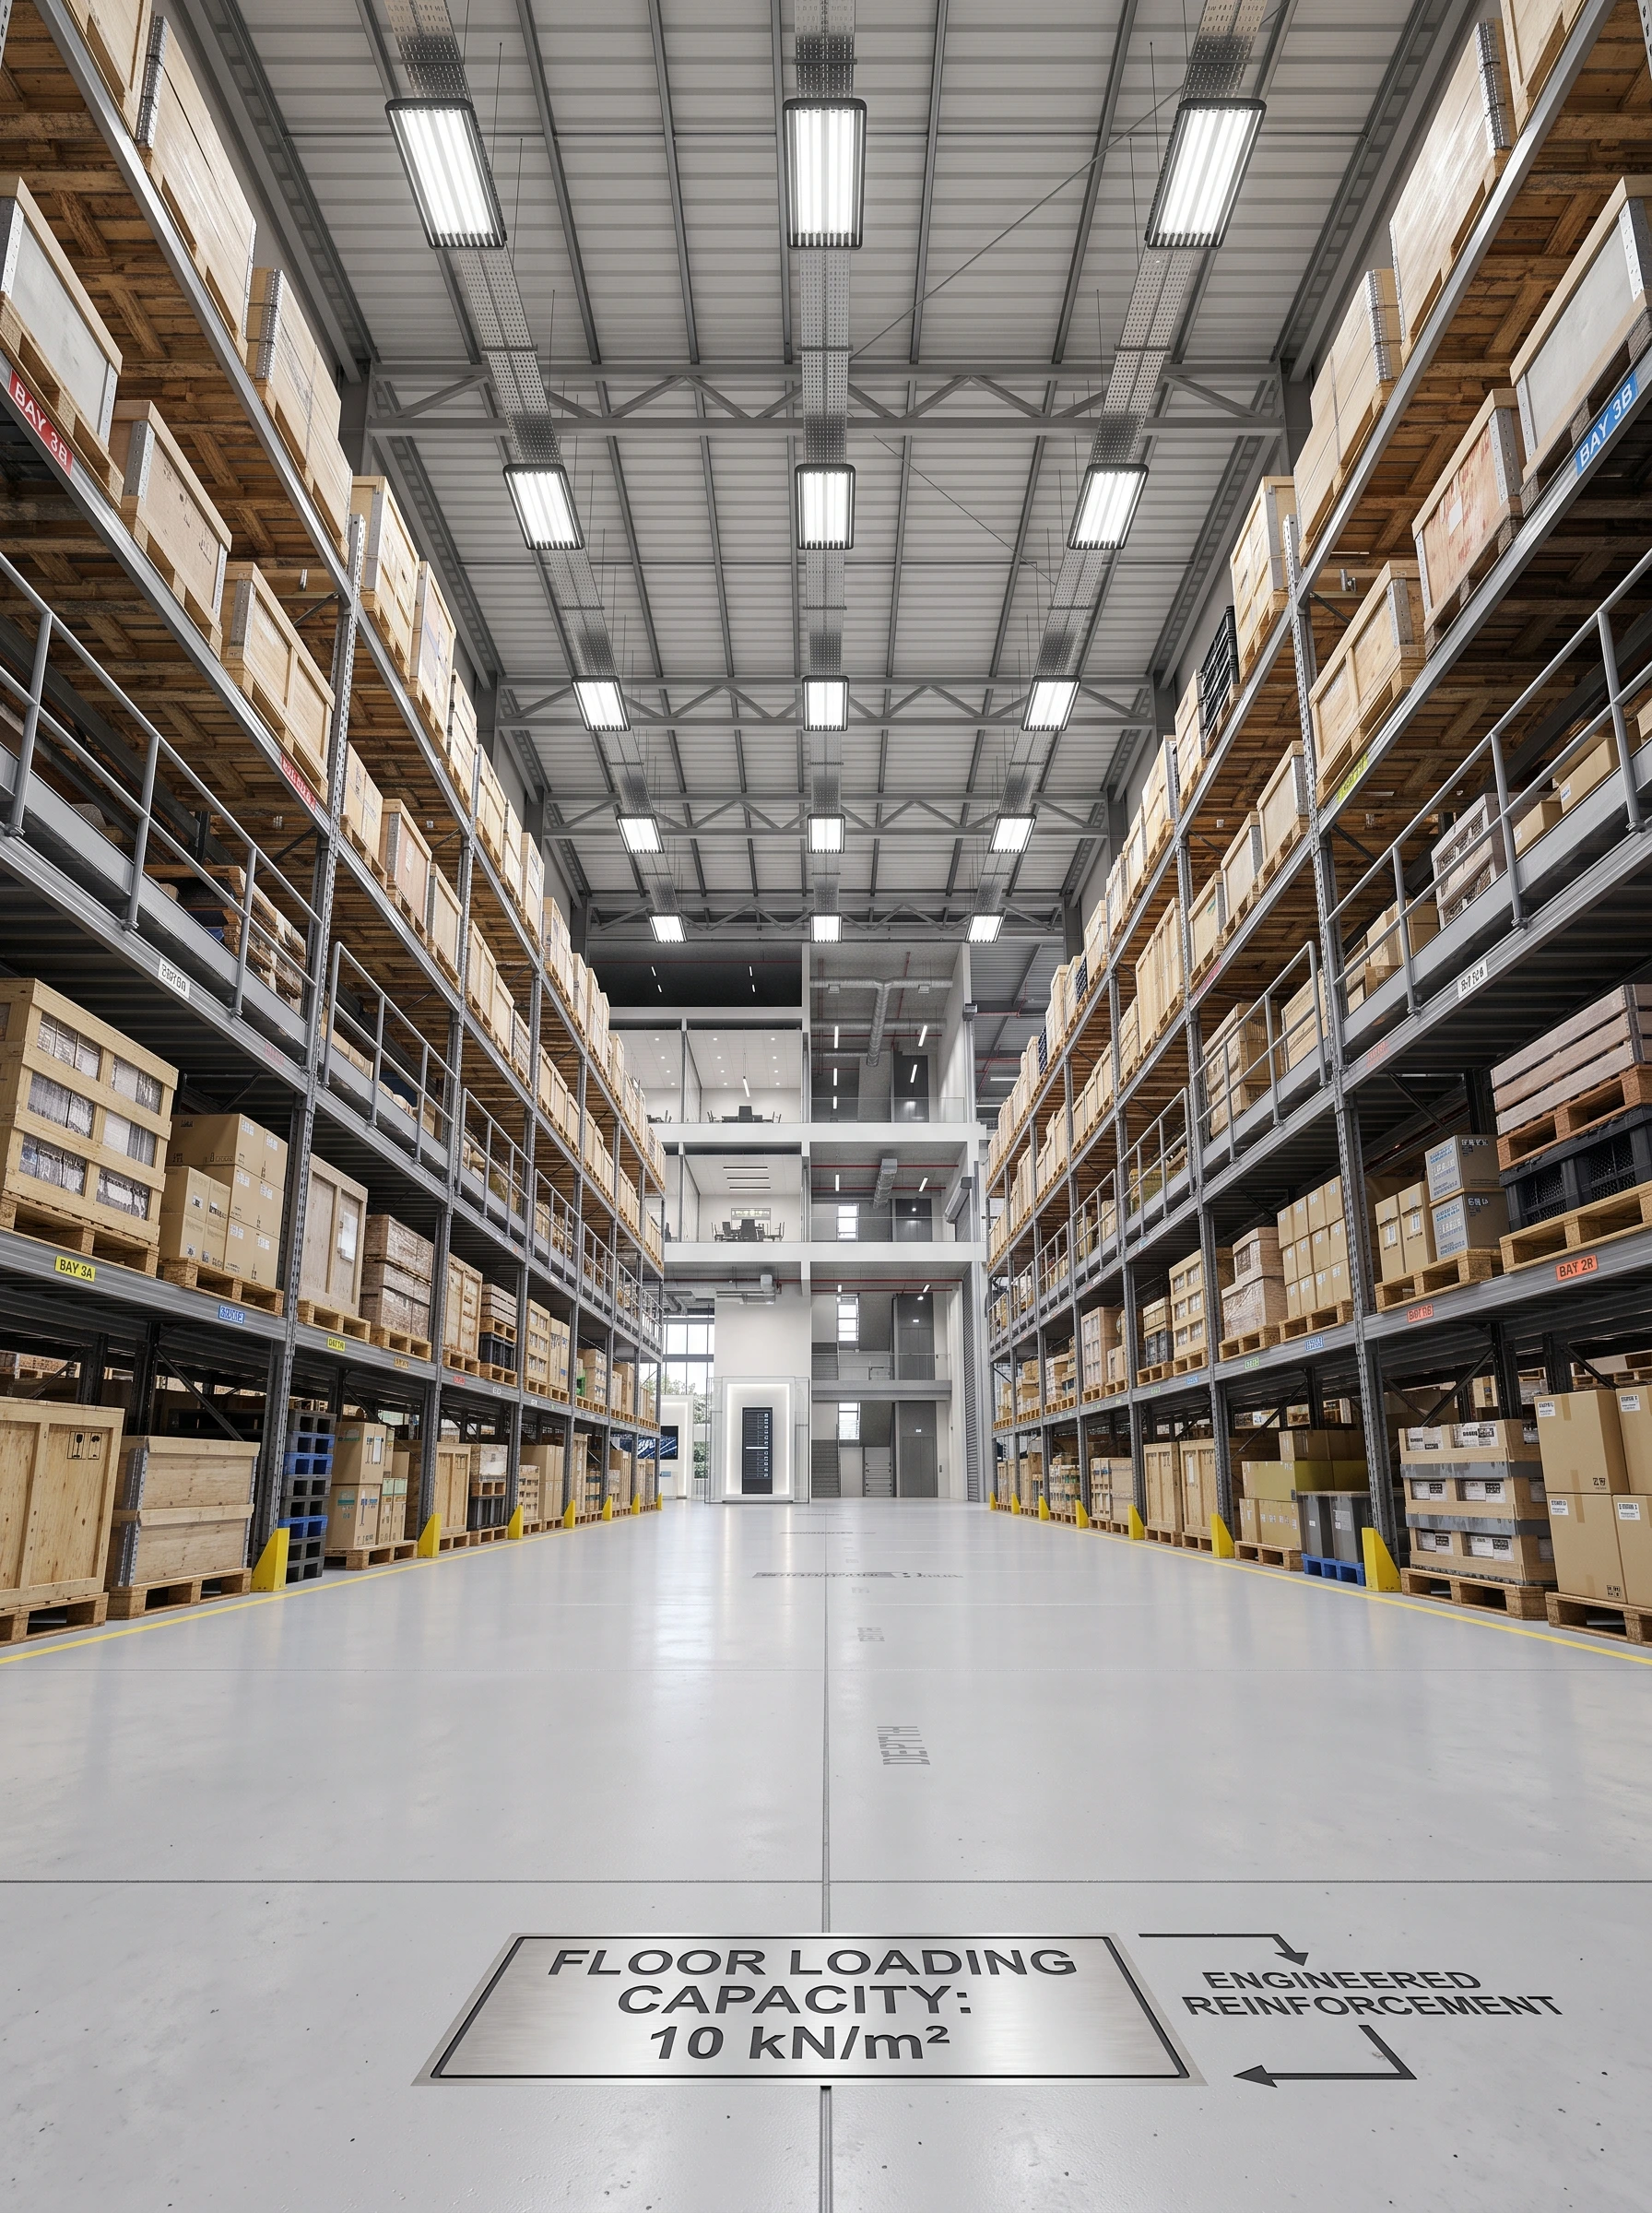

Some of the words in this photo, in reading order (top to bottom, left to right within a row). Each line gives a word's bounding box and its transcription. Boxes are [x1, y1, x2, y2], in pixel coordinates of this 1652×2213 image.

[15, 381, 46, 432] BAY
[1580, 413, 1609, 467] BAY
[1612, 383, 1633, 420] 3B
[59, 1259, 80, 1273] BAY
[80, 1265, 92, 1279] 3A
[1559, 1261, 1579, 1277] BAY
[1580, 1257, 1594, 1272] 2R
[548, 1949, 766, 1976] FLOOR
[789, 1949, 1078, 1976] LOADING
[1201, 1971, 1482, 1989] ENGINEERED
[618, 1985, 972, 2015] CAPACITY:
[1181, 1995, 1564, 2016] REINFORCEMENT
[650, 2026, 724, 2060] 10
[749, 2026, 950, 2060] kN/m²
